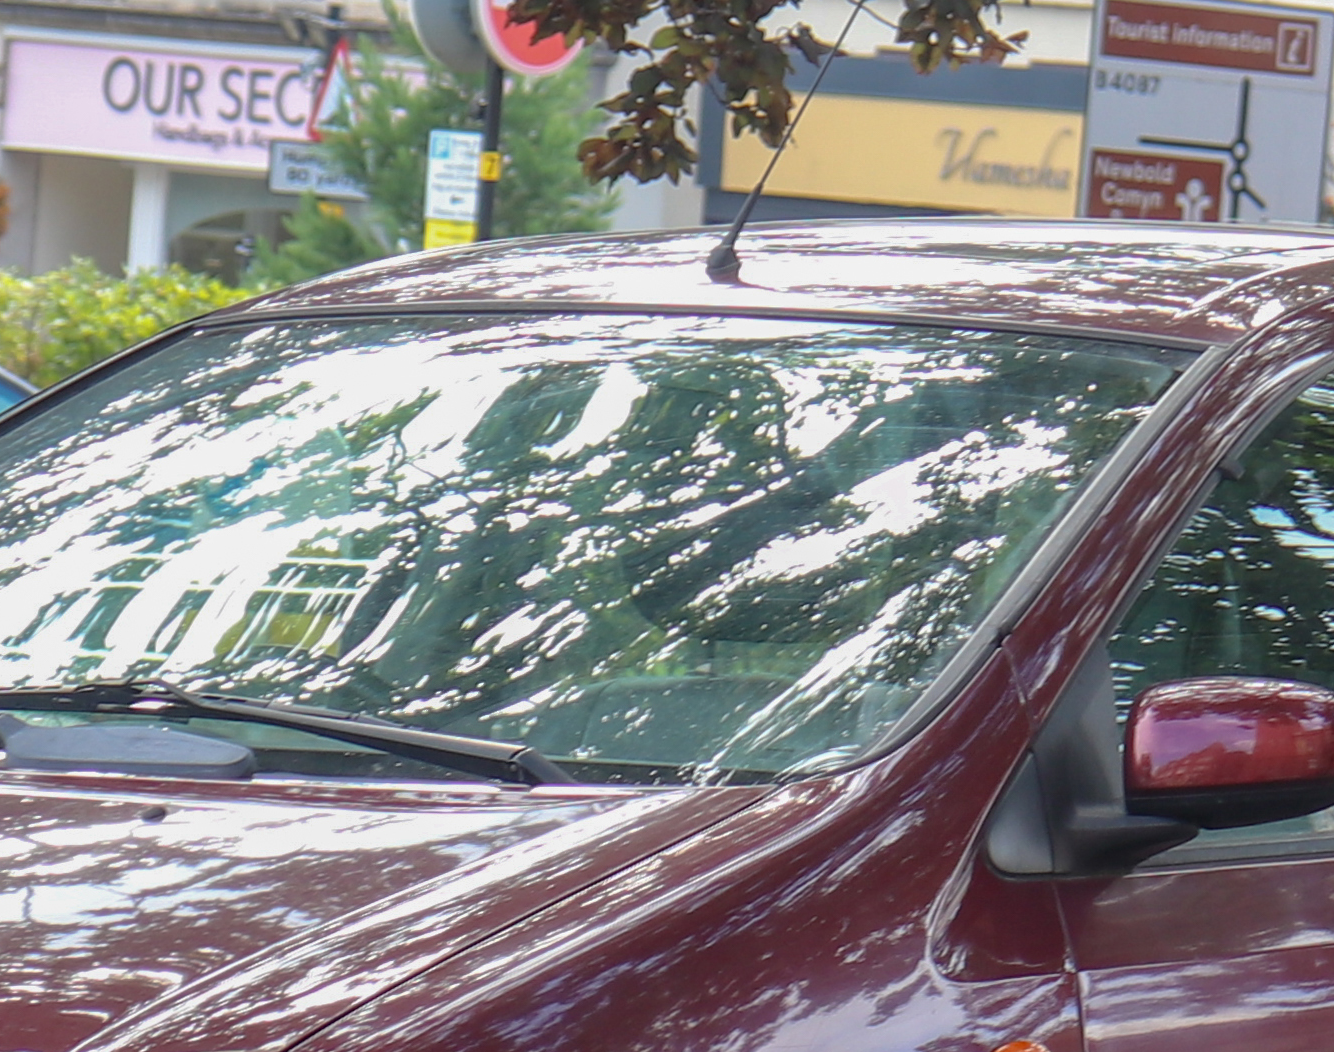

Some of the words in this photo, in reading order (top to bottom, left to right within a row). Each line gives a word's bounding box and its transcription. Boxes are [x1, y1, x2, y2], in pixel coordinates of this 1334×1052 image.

[1107, 15, 1170, 43] Tourist
[1172, 22, 1275, 53] information
[102, 55, 205, 118] OUR
[218, 65, 321, 127] SEC
[1094, 156, 1175, 185] Newbold
[1100, 181, 1164, 217] Comyn
